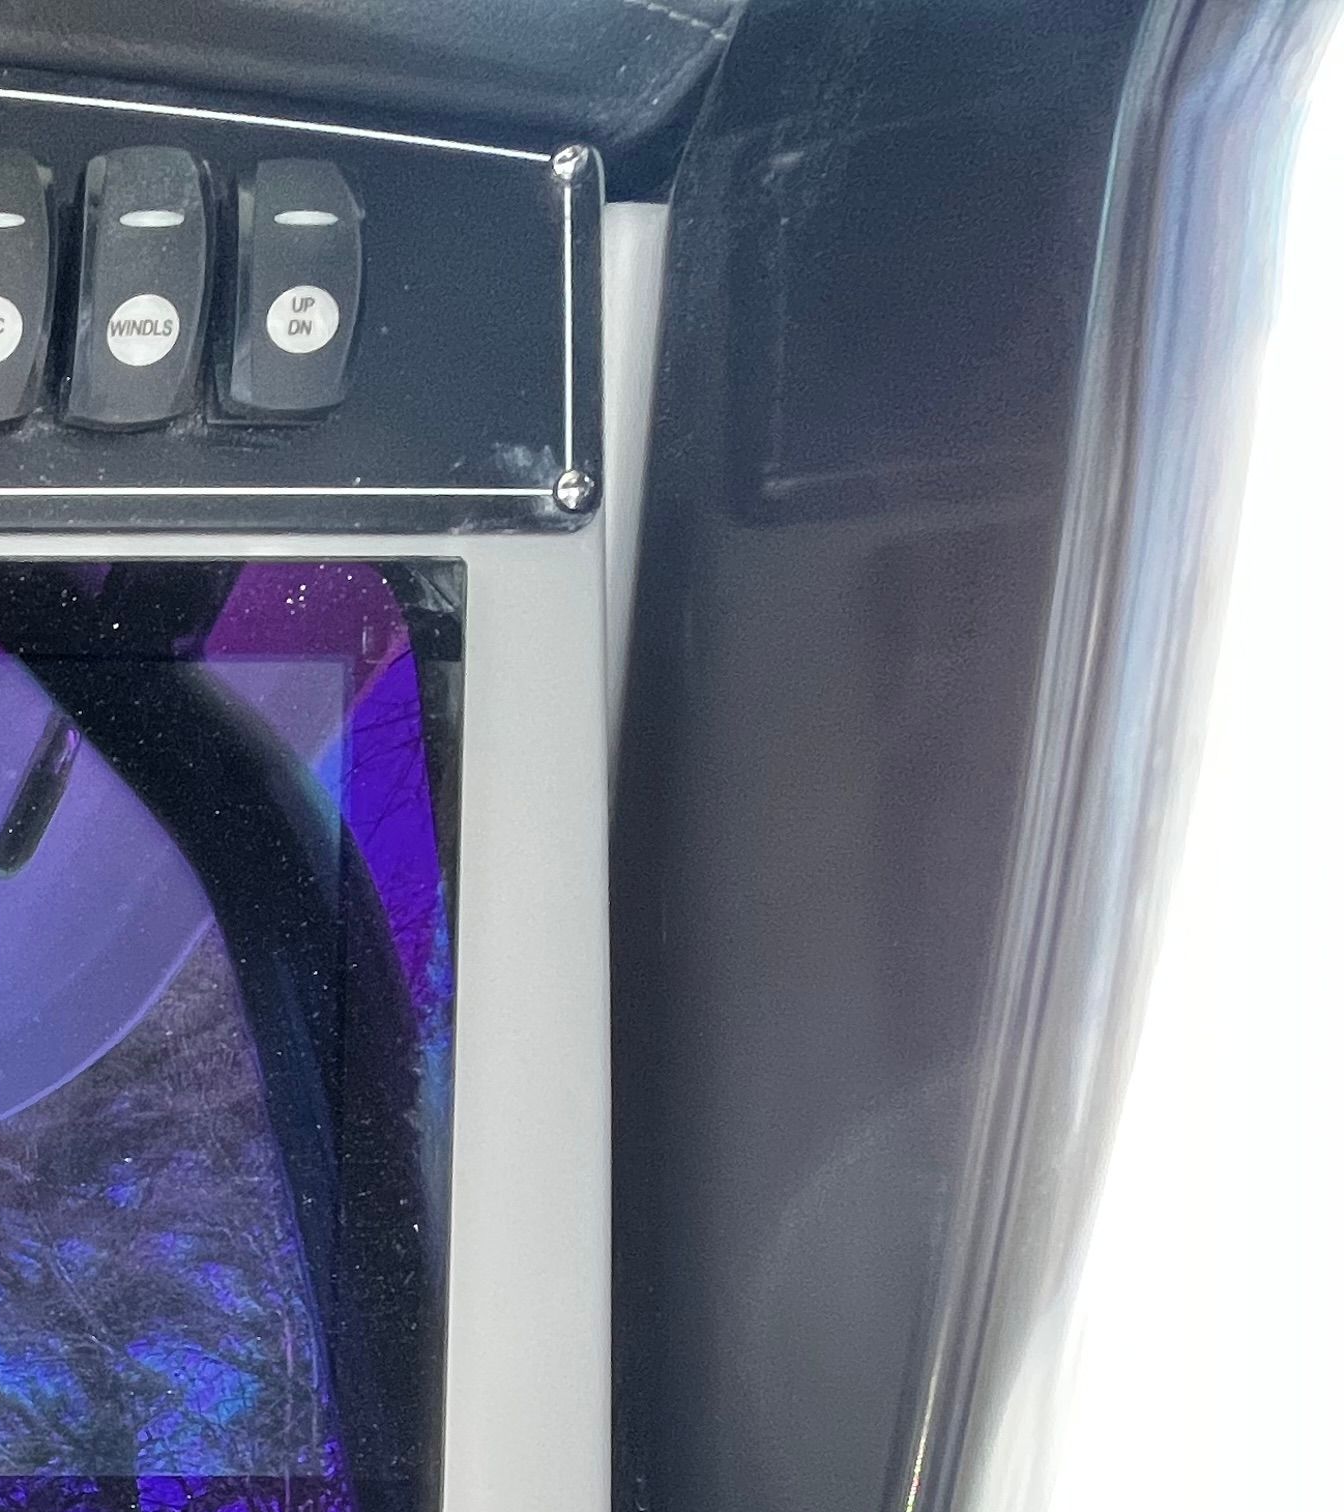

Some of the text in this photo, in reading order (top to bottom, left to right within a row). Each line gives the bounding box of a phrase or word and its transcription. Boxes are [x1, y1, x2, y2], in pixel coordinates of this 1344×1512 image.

[292, 297, 315, 314] UP
[110, 319, 173, 337] WINDLS
[287, 319, 313, 336] DN
